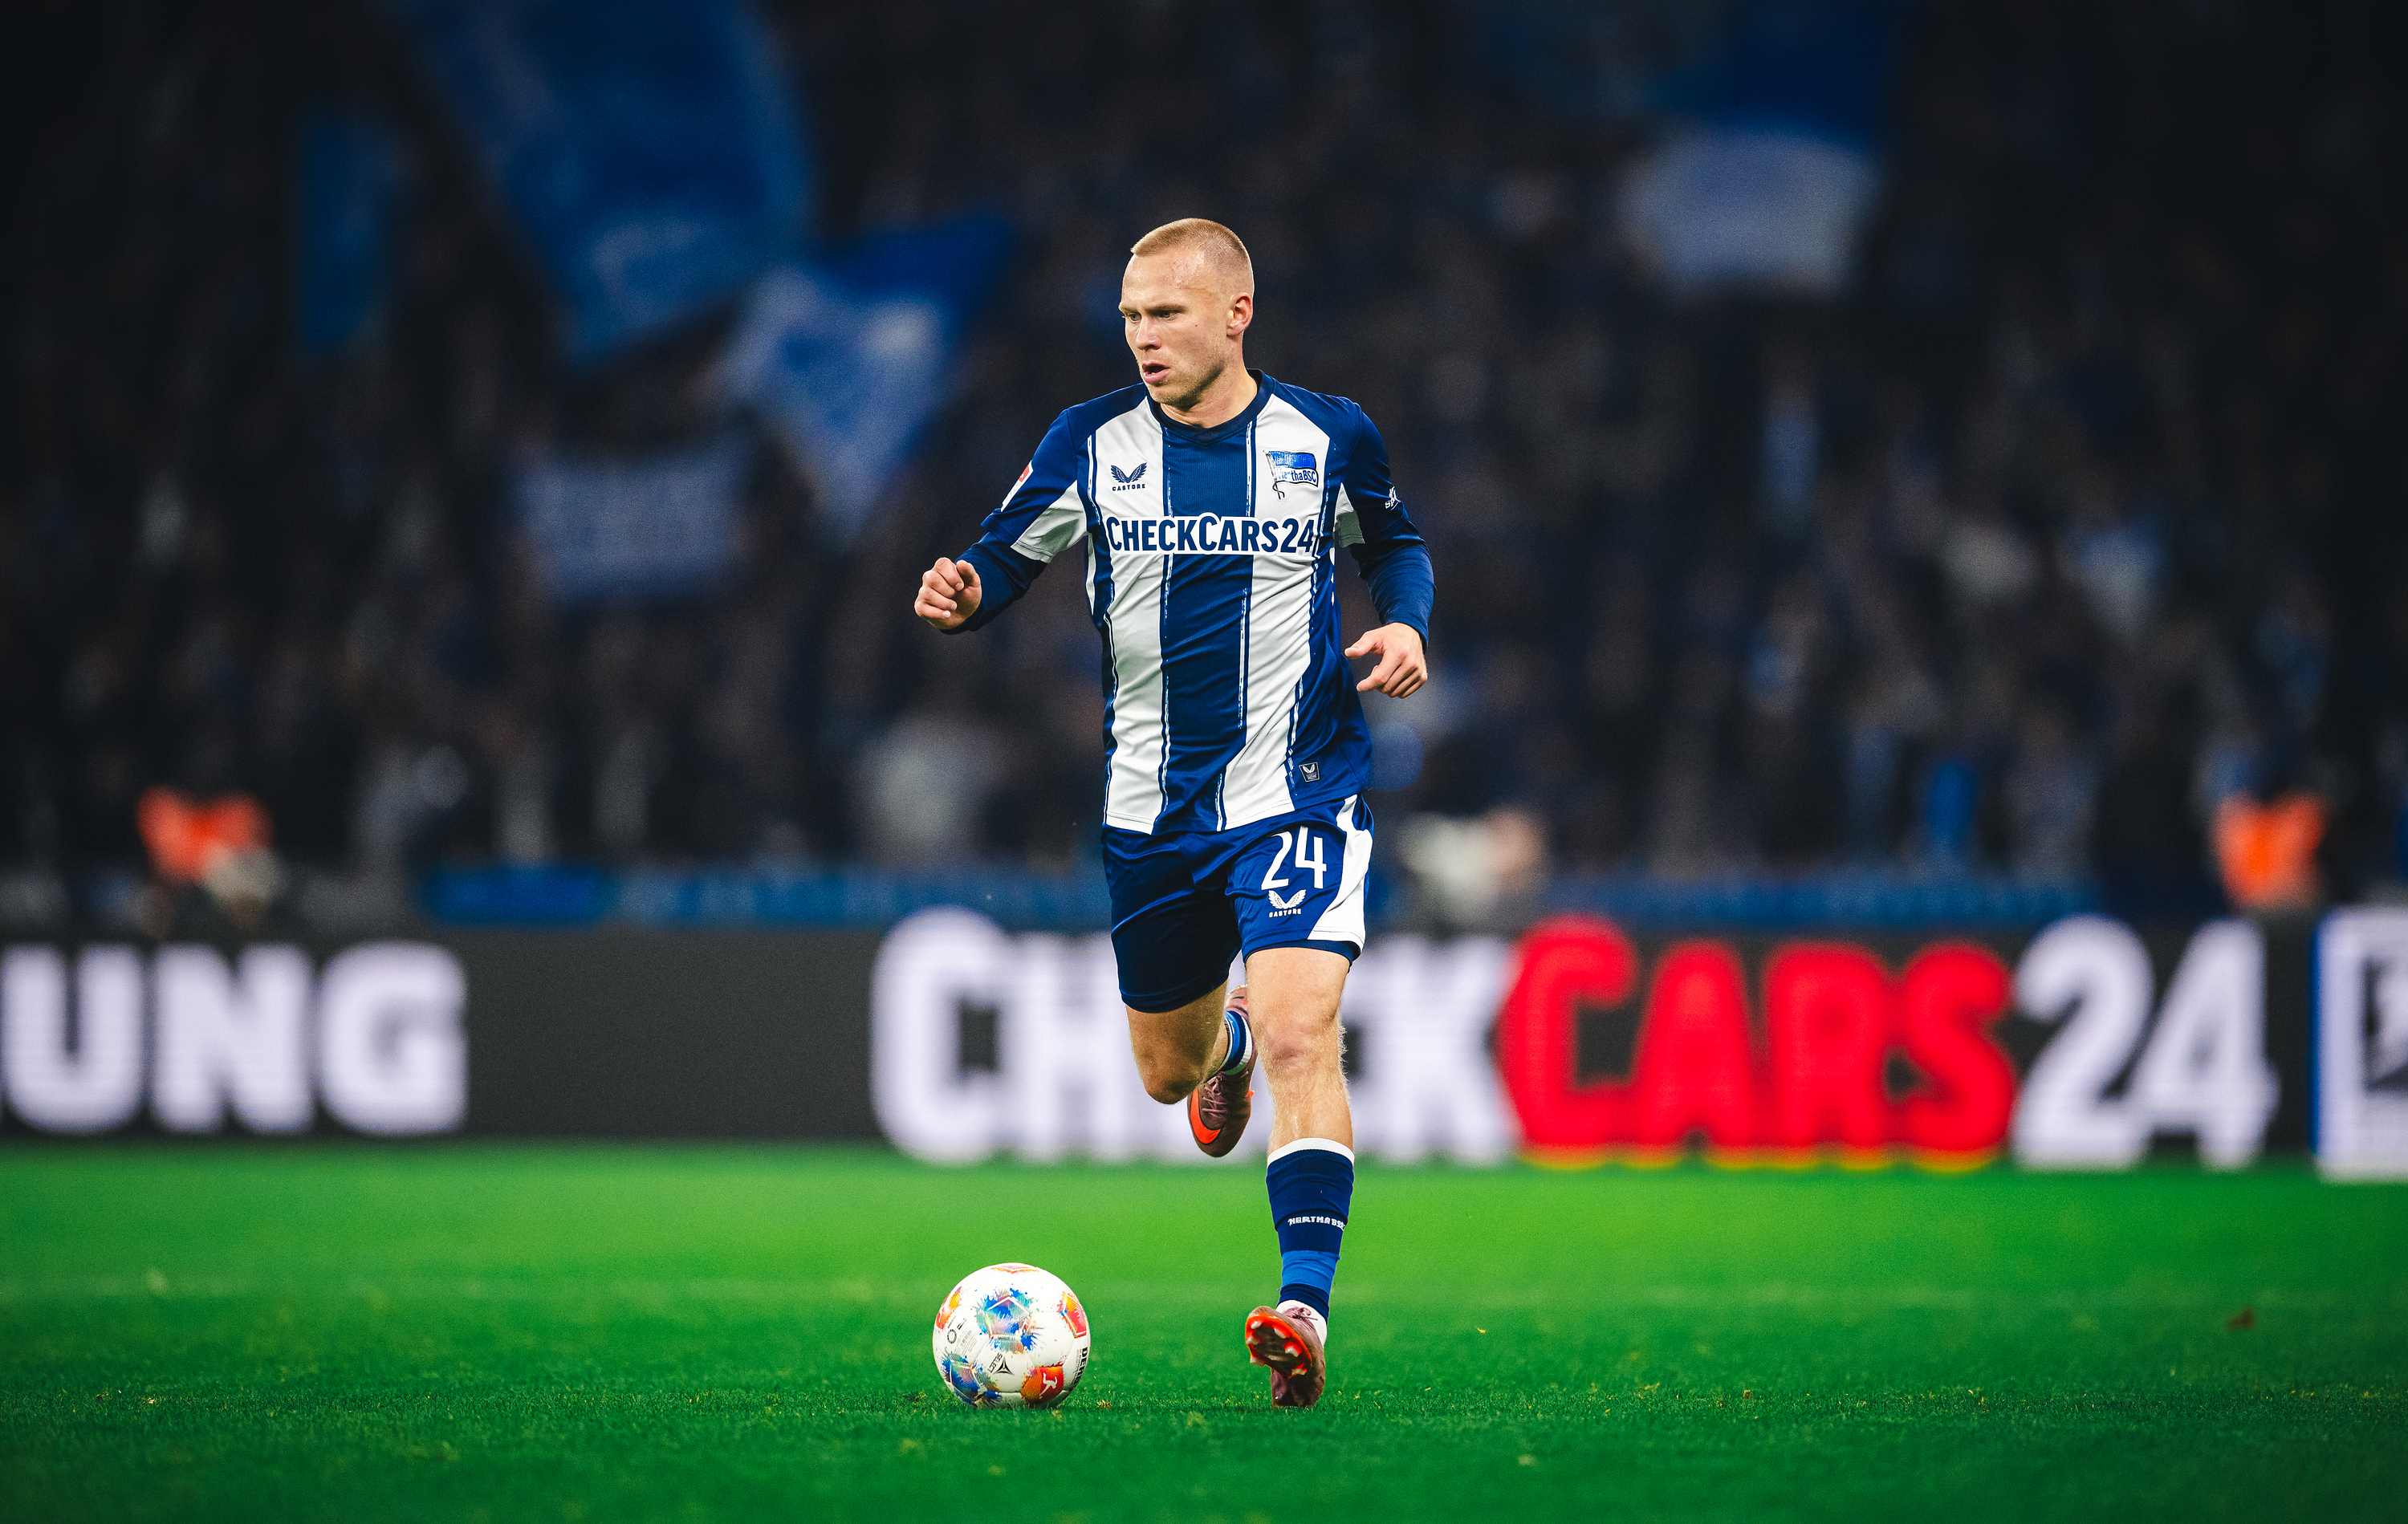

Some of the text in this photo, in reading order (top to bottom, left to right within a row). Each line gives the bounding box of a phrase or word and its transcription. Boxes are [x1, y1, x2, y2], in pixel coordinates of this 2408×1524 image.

[1112, 483, 1146, 492] CASTORE
[1106, 515, 1315, 553] CHECKCARS24
[1261, 825, 1327, 891] 24
[1268, 908, 1302, 918] CASTORE
[2, 939, 469, 1134] UNG
